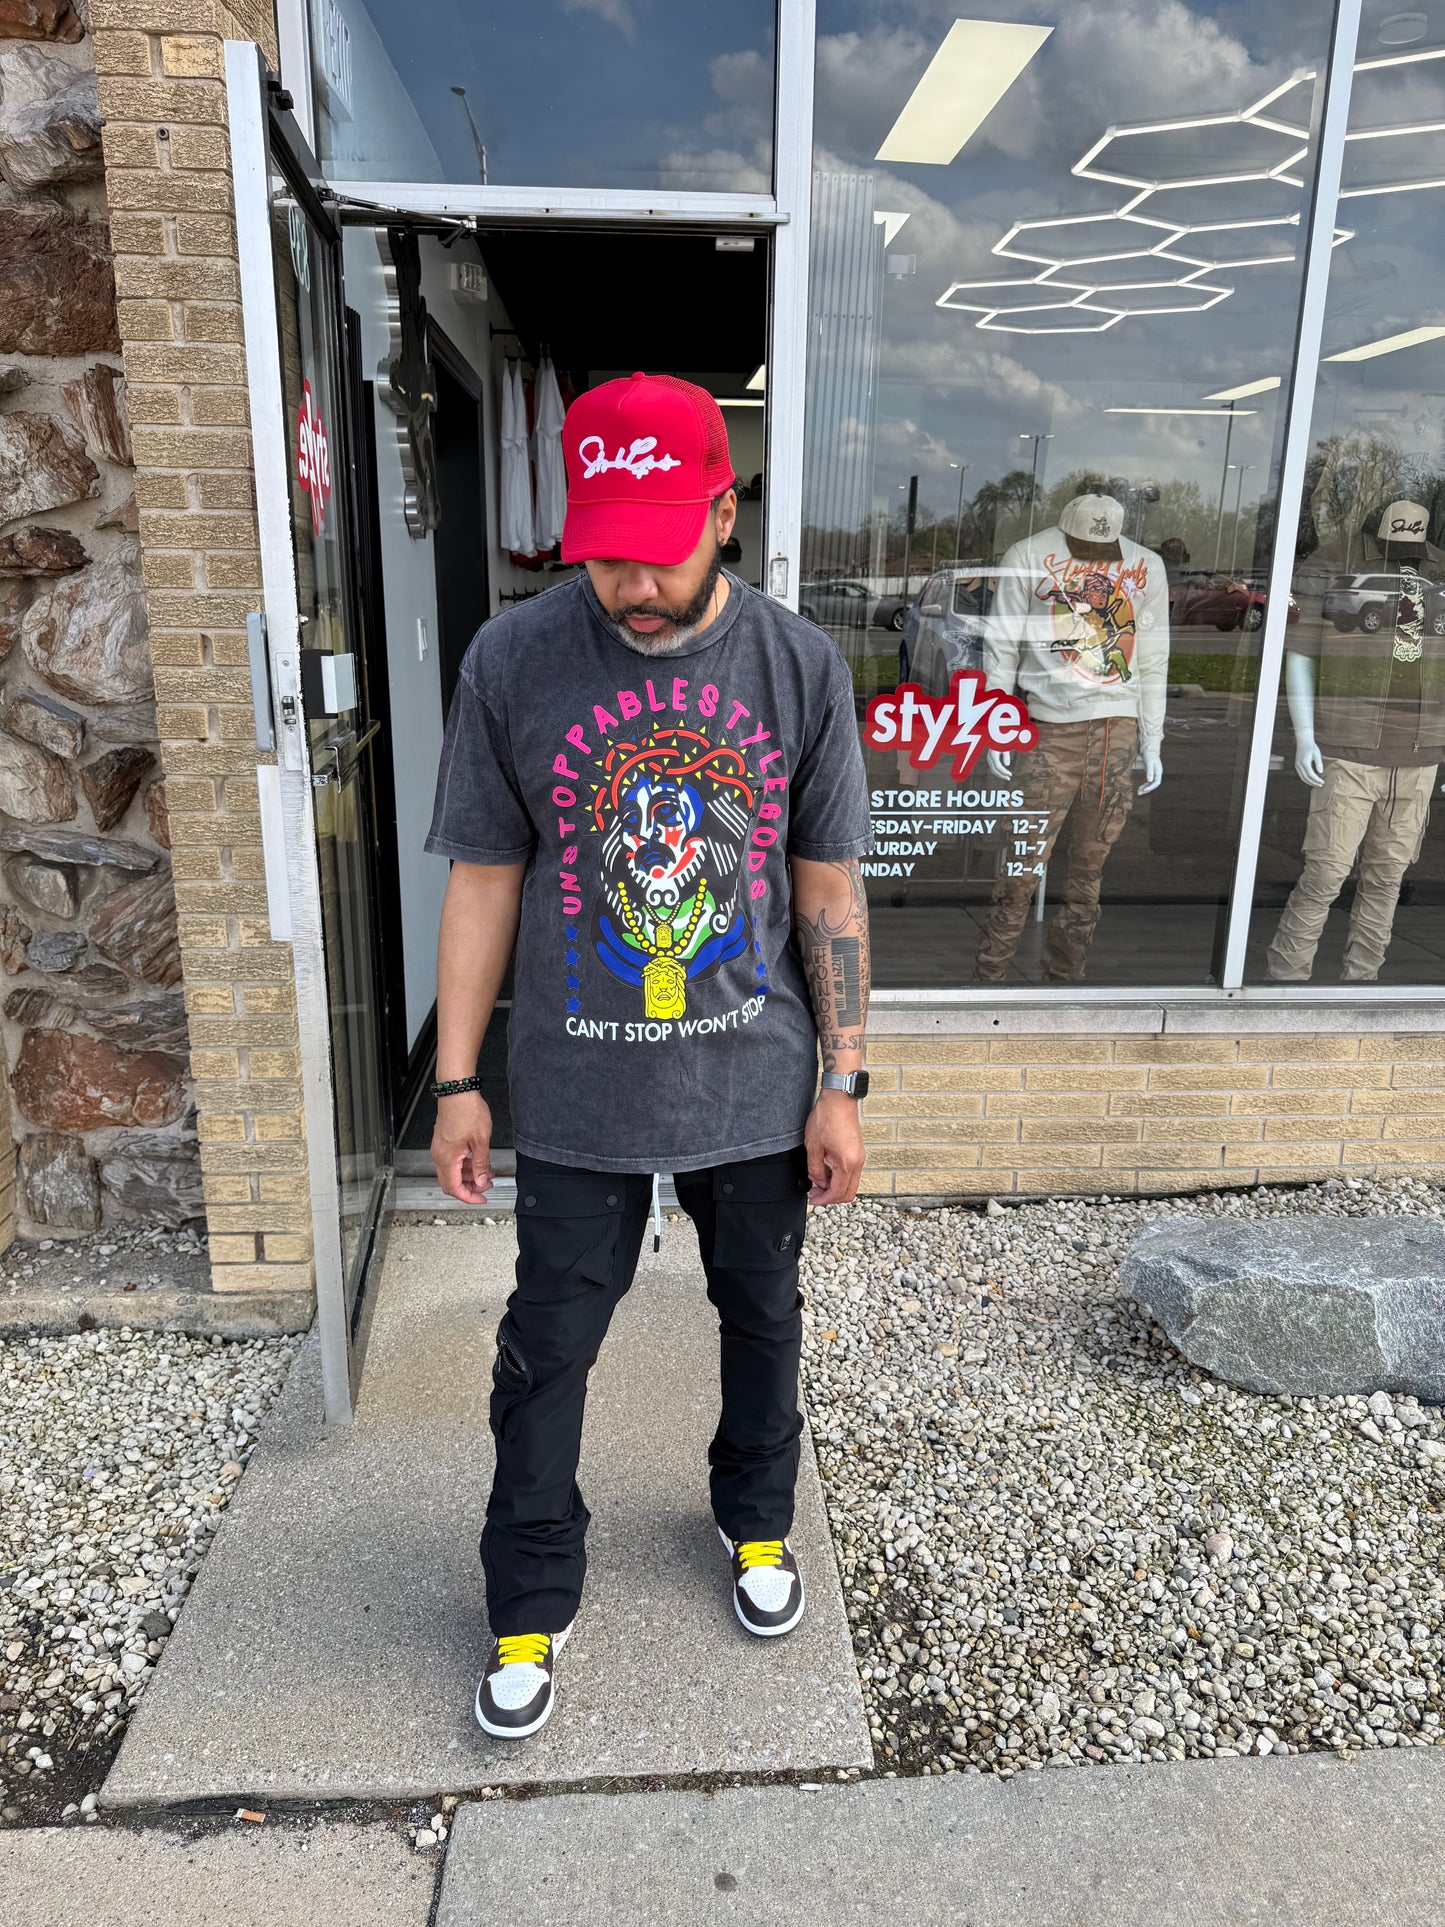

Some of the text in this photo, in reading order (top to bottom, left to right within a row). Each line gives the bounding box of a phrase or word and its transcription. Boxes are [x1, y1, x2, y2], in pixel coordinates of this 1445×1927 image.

[871, 790, 1024, 808] STORE HOURS
[870, 819, 1049, 834] ESDAY-FRIDAY 12-7
[1014, 841, 1047, 856] 11-7
[1006, 863, 1044, 877] 12-4
[565, 995, 766, 1042] CAN'T STOP WON'T STOP
